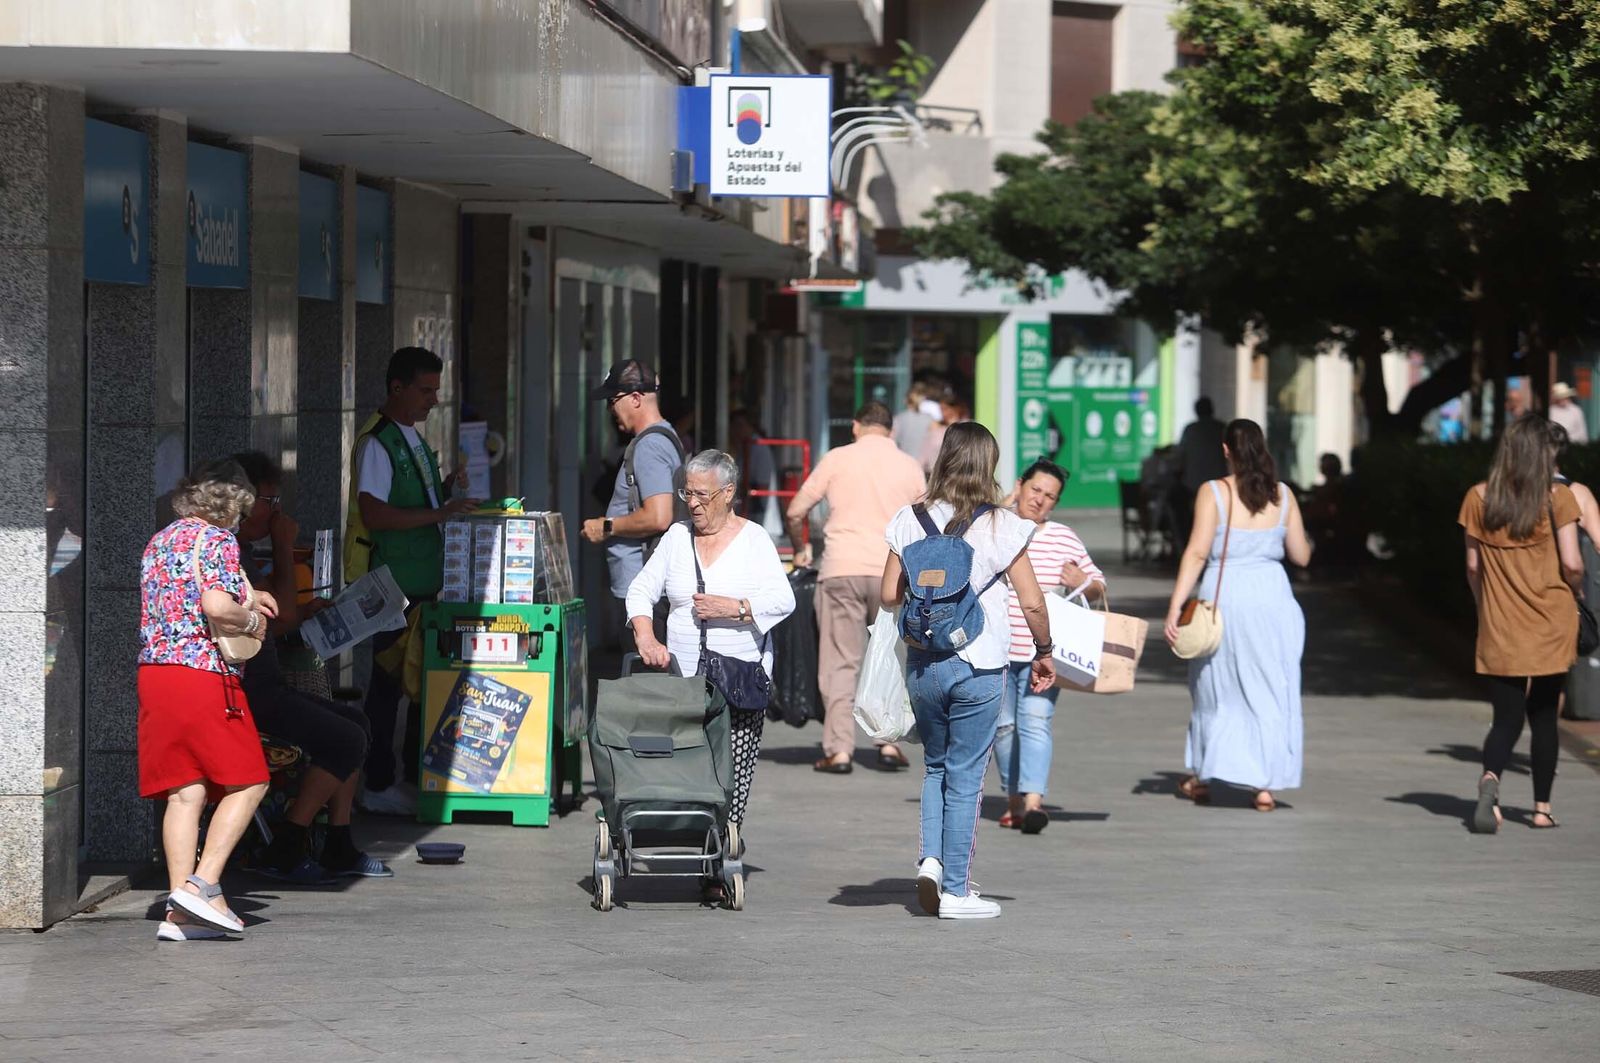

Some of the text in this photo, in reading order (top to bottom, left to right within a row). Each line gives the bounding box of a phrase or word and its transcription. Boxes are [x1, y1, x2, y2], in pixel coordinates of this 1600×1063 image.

[727, 147, 785, 161] Loterías y
[727, 161, 802, 174] Apuestas del
[727, 174, 766, 185] Estado
[195, 200, 239, 267] Sabadell
[1060, 647, 1096, 672] LOLA
[458, 681, 485, 700] San
[483, 690, 523, 714] Juan
